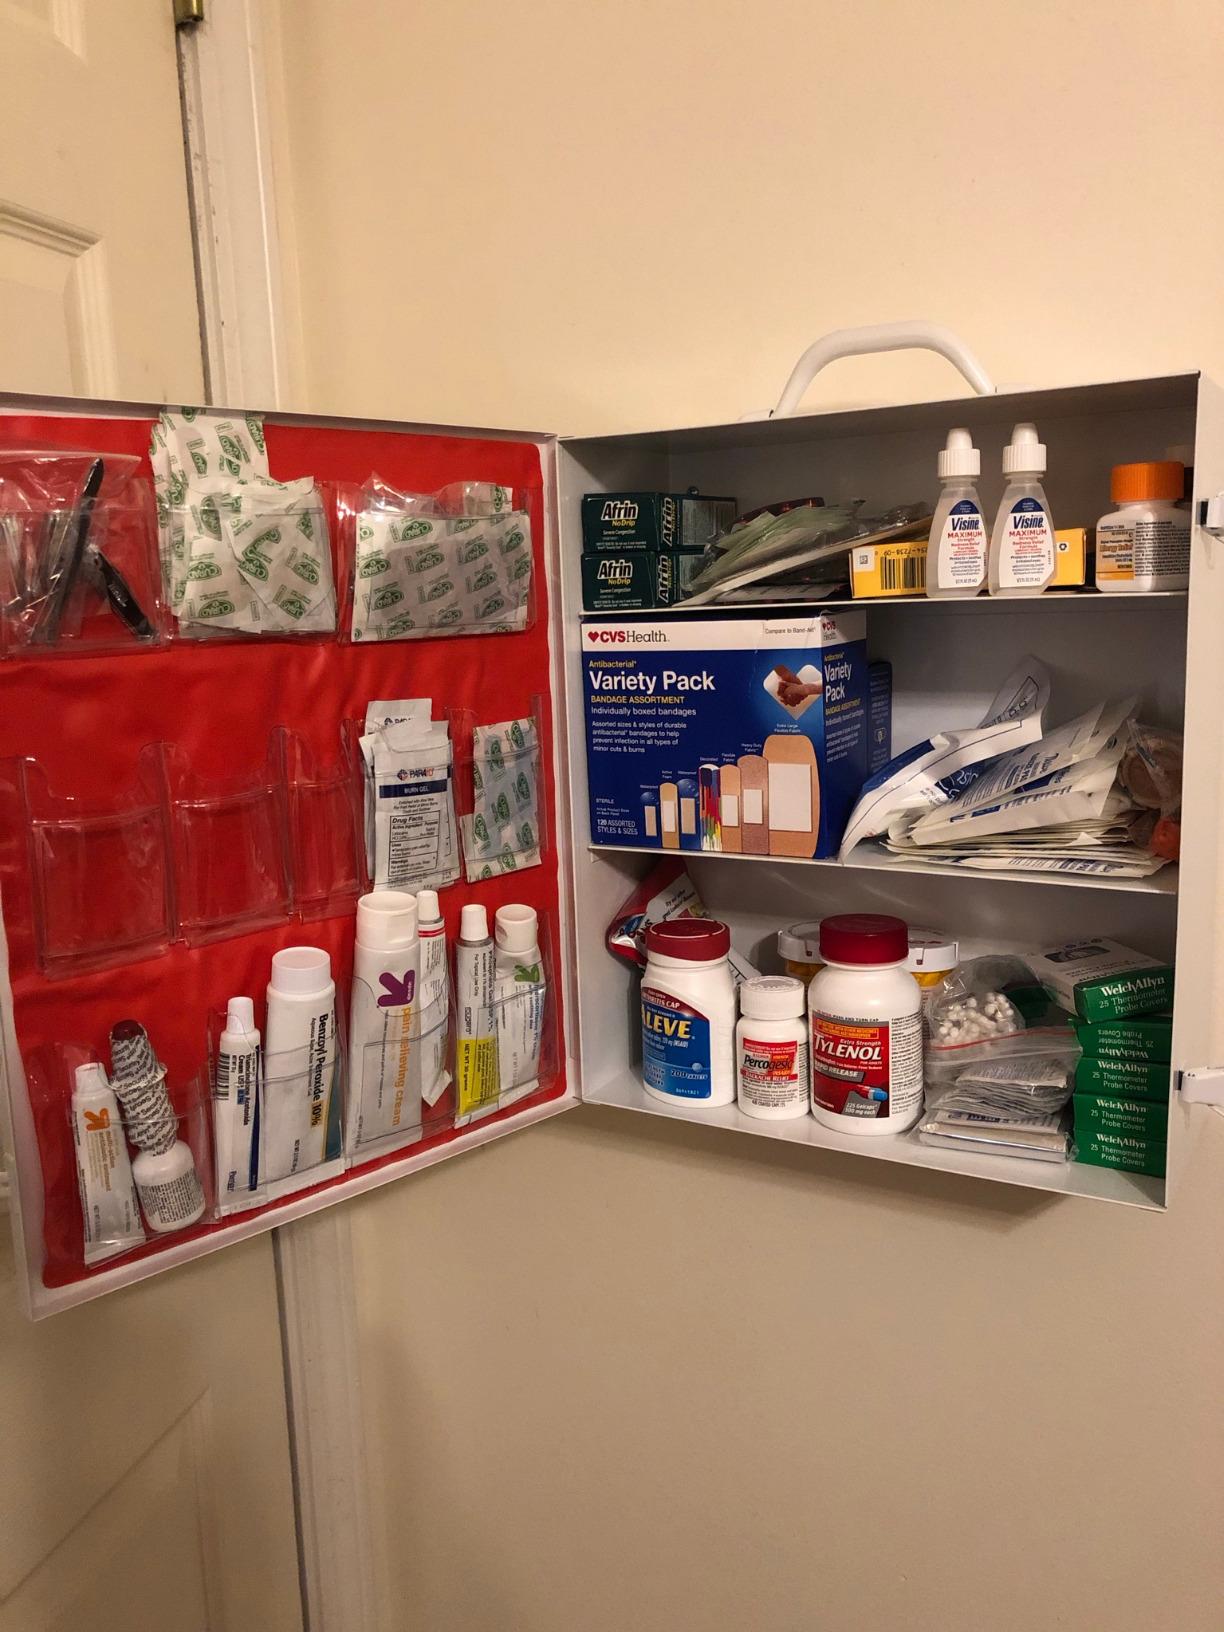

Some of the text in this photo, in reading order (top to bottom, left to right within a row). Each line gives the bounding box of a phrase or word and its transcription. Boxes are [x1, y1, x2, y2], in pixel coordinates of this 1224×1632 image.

[601, 500, 639, 520] Afrin
[662, 497, 672, 546] Afrin
[952, 517, 979, 531] Visine
[1014, 515, 1044, 529] Visine
[403, 522, 430, 540] CURAD
[1009, 529, 1047, 537] MAXIMUM
[361, 560, 388, 578] CURAD
[597, 559, 633, 579] Afrin
[659, 555, 668, 603] Afrin
[825, 662, 852, 680] Variety
[589, 671, 716, 694] Variety Pack
[629, 696, 684, 704] ASSORTMENT
[825, 685, 845, 702] Pack
[592, 707, 696, 717] Individually boxed bandages
[667, 730, 679, 738] help
[1101, 977, 1165, 996] WelchAllyn
[666, 1001, 680, 1009] CAP
[1099, 989, 1166, 1008] 25 Thermometer
[1115, 997, 1168, 1014] Probe Covers
[1123, 1031, 1142, 1039] Probe
[814, 1033, 882, 1060] TYLENOL
[1098, 1038, 1142, 1047] Thermometer
[1098, 1048, 1149, 1058] WelchAllyn
[392, 1007, 412, 1126] pain relieving cream
[744, 1054, 793, 1070] Percogesic
[1098, 1061, 1148, 1074] WelchAllyn
[311, 1014, 329, 1126] Benzoyl Peroxide 10%
[829, 1065, 858, 1077] RELEASE
[122, 1073, 149, 1090] Security
[1103, 1072, 1147, 1083] Thermometer
[1103, 1080, 1148, 1091] Probe Covers
[1096, 1099, 1146, 1113] WelchAllyn
[1102, 1111, 1146, 1122] Thermometer
[1101, 1119, 1145, 1131] Probe Covers
[1096, 1134, 1146, 1149] WelchAllyn
[1102, 1145, 1145, 1158] Thermometer
[1101, 1153, 1145, 1166] Probe Covers
